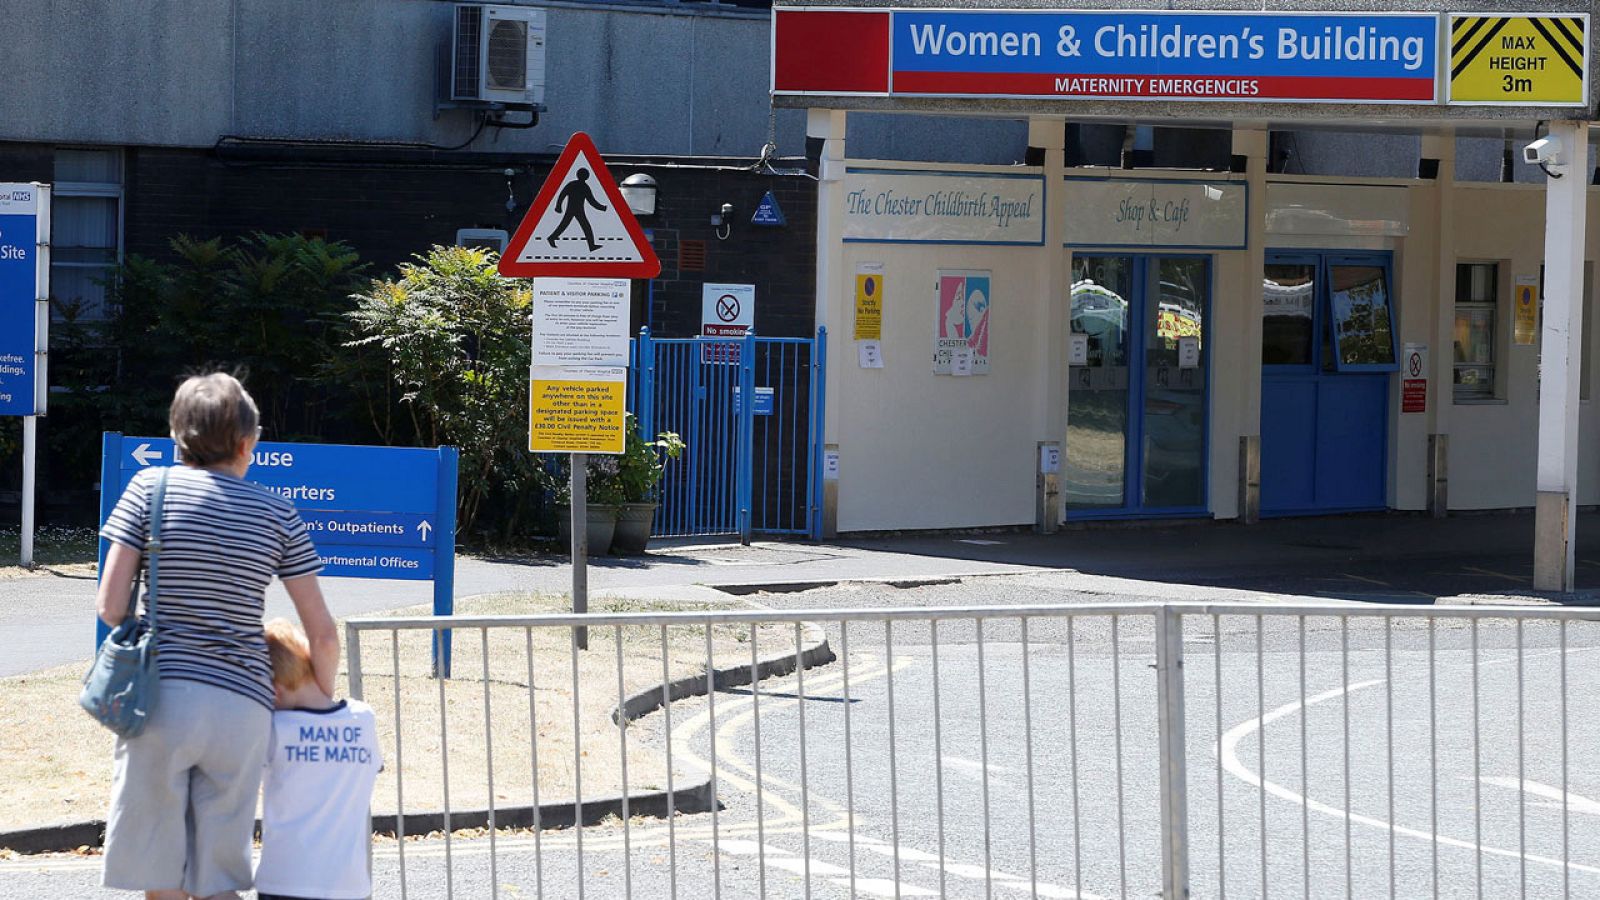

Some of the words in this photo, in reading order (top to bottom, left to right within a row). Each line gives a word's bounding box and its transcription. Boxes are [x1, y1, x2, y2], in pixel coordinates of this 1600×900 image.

[910, 24, 1041, 56] Women
[1056, 25, 1082, 57] &
[1094, 24, 1264, 60] Children’s
[1277, 26, 1424, 71] Building
[1502, 36, 1536, 50] MAX
[1489, 57, 1547, 70] HEIGHT
[1055, 77, 1145, 93] MATERNITY
[1150, 79, 1259, 95] EMERGENCIES
[1502, 75, 1532, 92] 3m
[12, 191, 31, 201] NHS
[847, 189, 871, 215] The
[874, 189, 922, 216] Chester
[924, 190, 987, 217] Childbirth
[988, 192, 1034, 227] Appeal
[1116, 197, 1144, 230] Shop
[1149, 198, 1161, 221] &
[1164, 198, 1190, 232] Café
[1, 244, 26, 260] Site
[707, 327, 717, 335] No
[542, 393, 574, 401] anywhere
[248, 450, 294, 467] ouse
[327, 520, 405, 535] Outpatients
[379, 556, 419, 569] Offices
[299, 726, 338, 742] MAN
[343, 727, 362, 743] OF
[285, 746, 320, 762] THE
